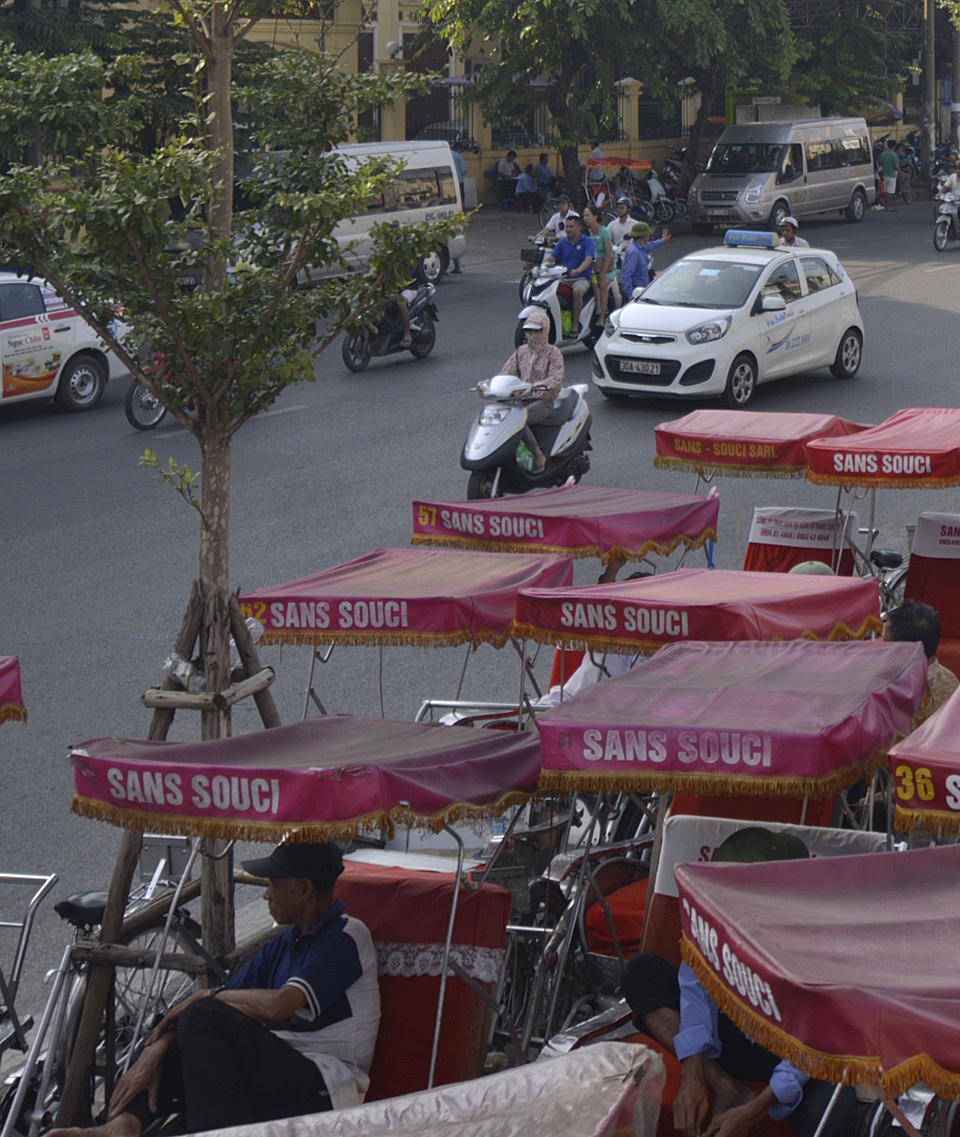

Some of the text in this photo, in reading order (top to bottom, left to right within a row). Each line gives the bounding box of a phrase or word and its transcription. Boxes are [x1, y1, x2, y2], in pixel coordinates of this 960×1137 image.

[674, 438, 702, 454] SANS
[713, 442, 747, 457] SOUCI
[749, 444, 778, 458] SARL
[833, 453, 932, 474] SANS SOUCI
[417, 505, 544, 538] 57 SANS SOUCI
[270, 601, 330, 629] SANS
[338, 601, 408, 629] SOUCI
[561, 602, 689, 636] SANS SOUCI
[583, 729, 667, 763] SANS
[677, 731, 772, 767] SOUCI
[107, 767, 279, 814] SANS SOUCI
[895, 765, 935, 801] 36
[722, 943, 782, 1022] SOUCI
